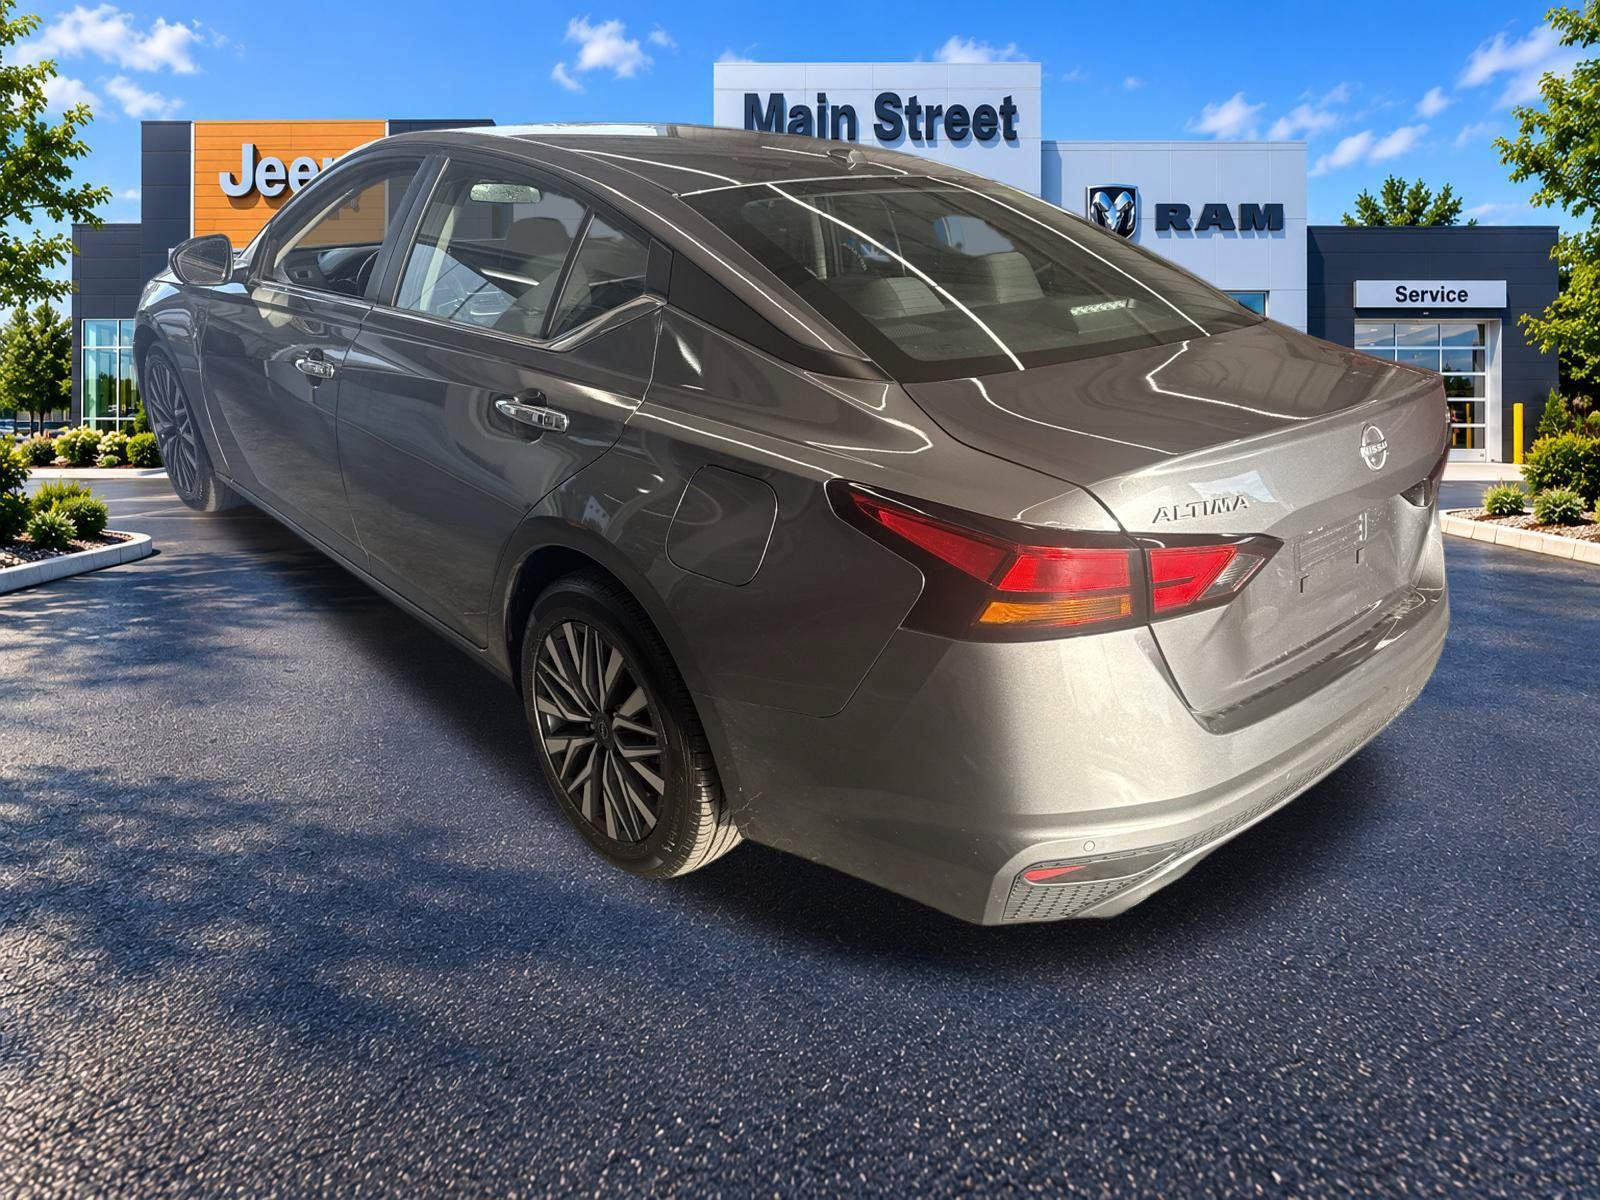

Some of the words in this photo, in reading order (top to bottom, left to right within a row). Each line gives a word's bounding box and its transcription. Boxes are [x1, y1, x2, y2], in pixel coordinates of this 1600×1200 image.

[744, 92, 856, 141] Main
[873, 91, 1018, 142] Street
[1155, 203, 1285, 232] RAM
[1395, 285, 1469, 303] Service
[1152, 494, 1249, 524] ALTIMA
